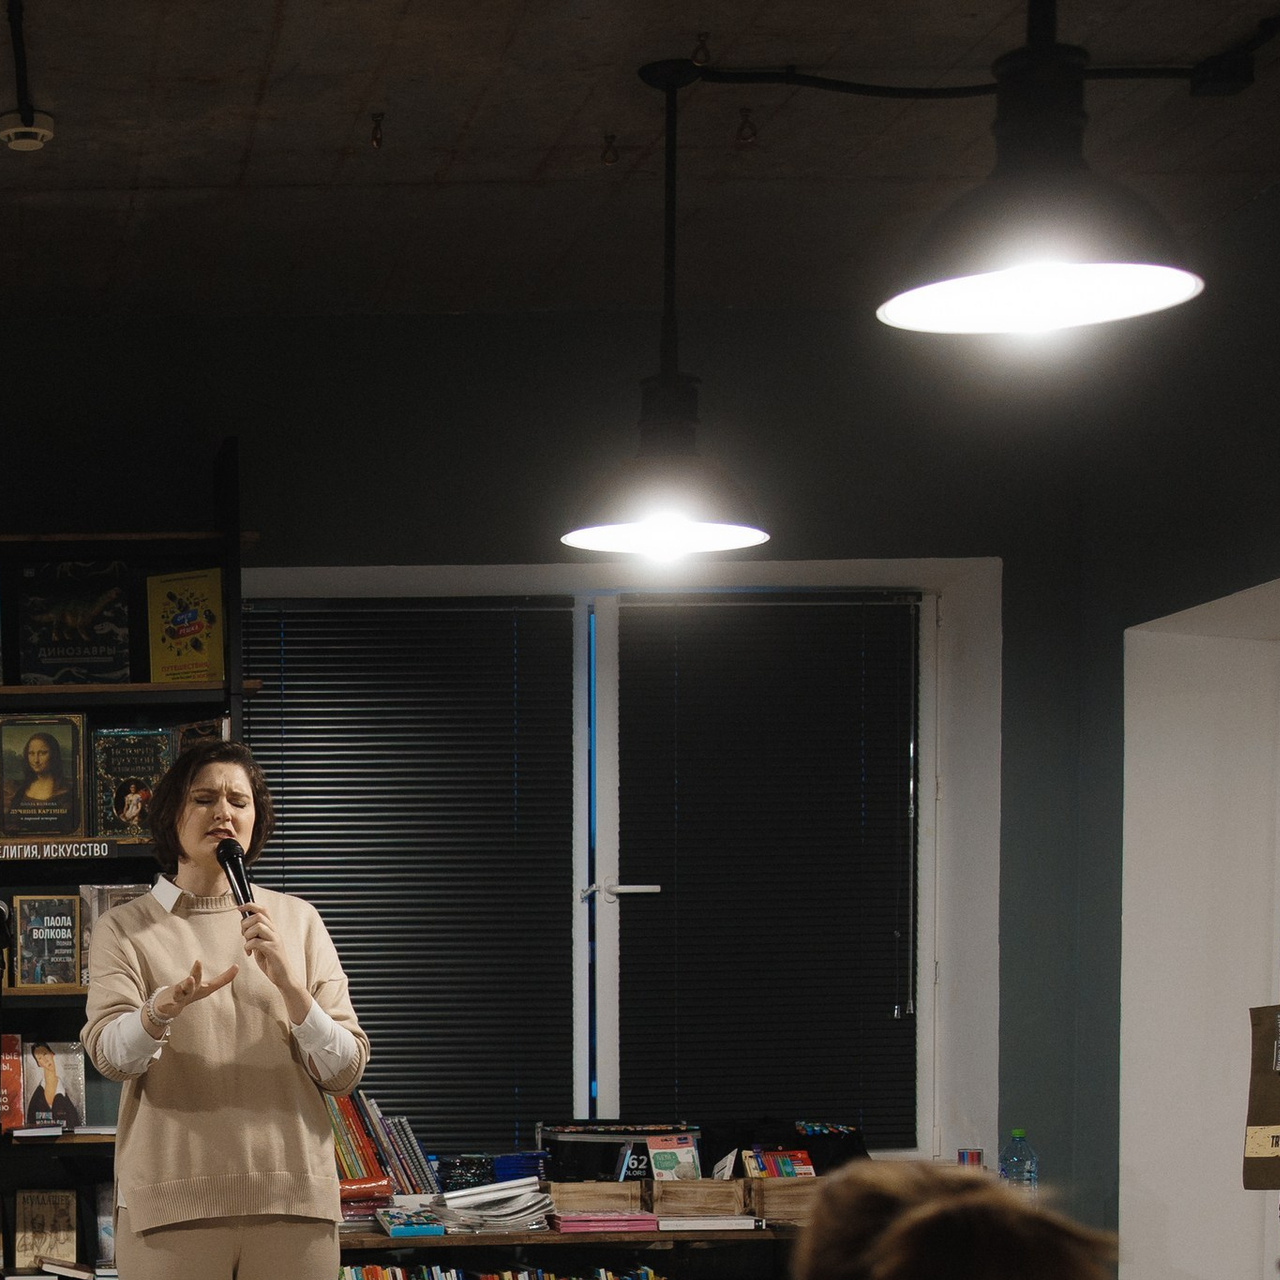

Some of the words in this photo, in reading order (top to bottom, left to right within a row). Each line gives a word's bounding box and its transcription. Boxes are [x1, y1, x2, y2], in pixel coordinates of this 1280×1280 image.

[38, 646, 116, 658] ДИНОЗАВРЫ
[43, 843, 108, 857] ИСКУССТВО
[44, 916, 72, 927] ПАОЛА
[33, 928, 72, 939] ВОЛКОВА
